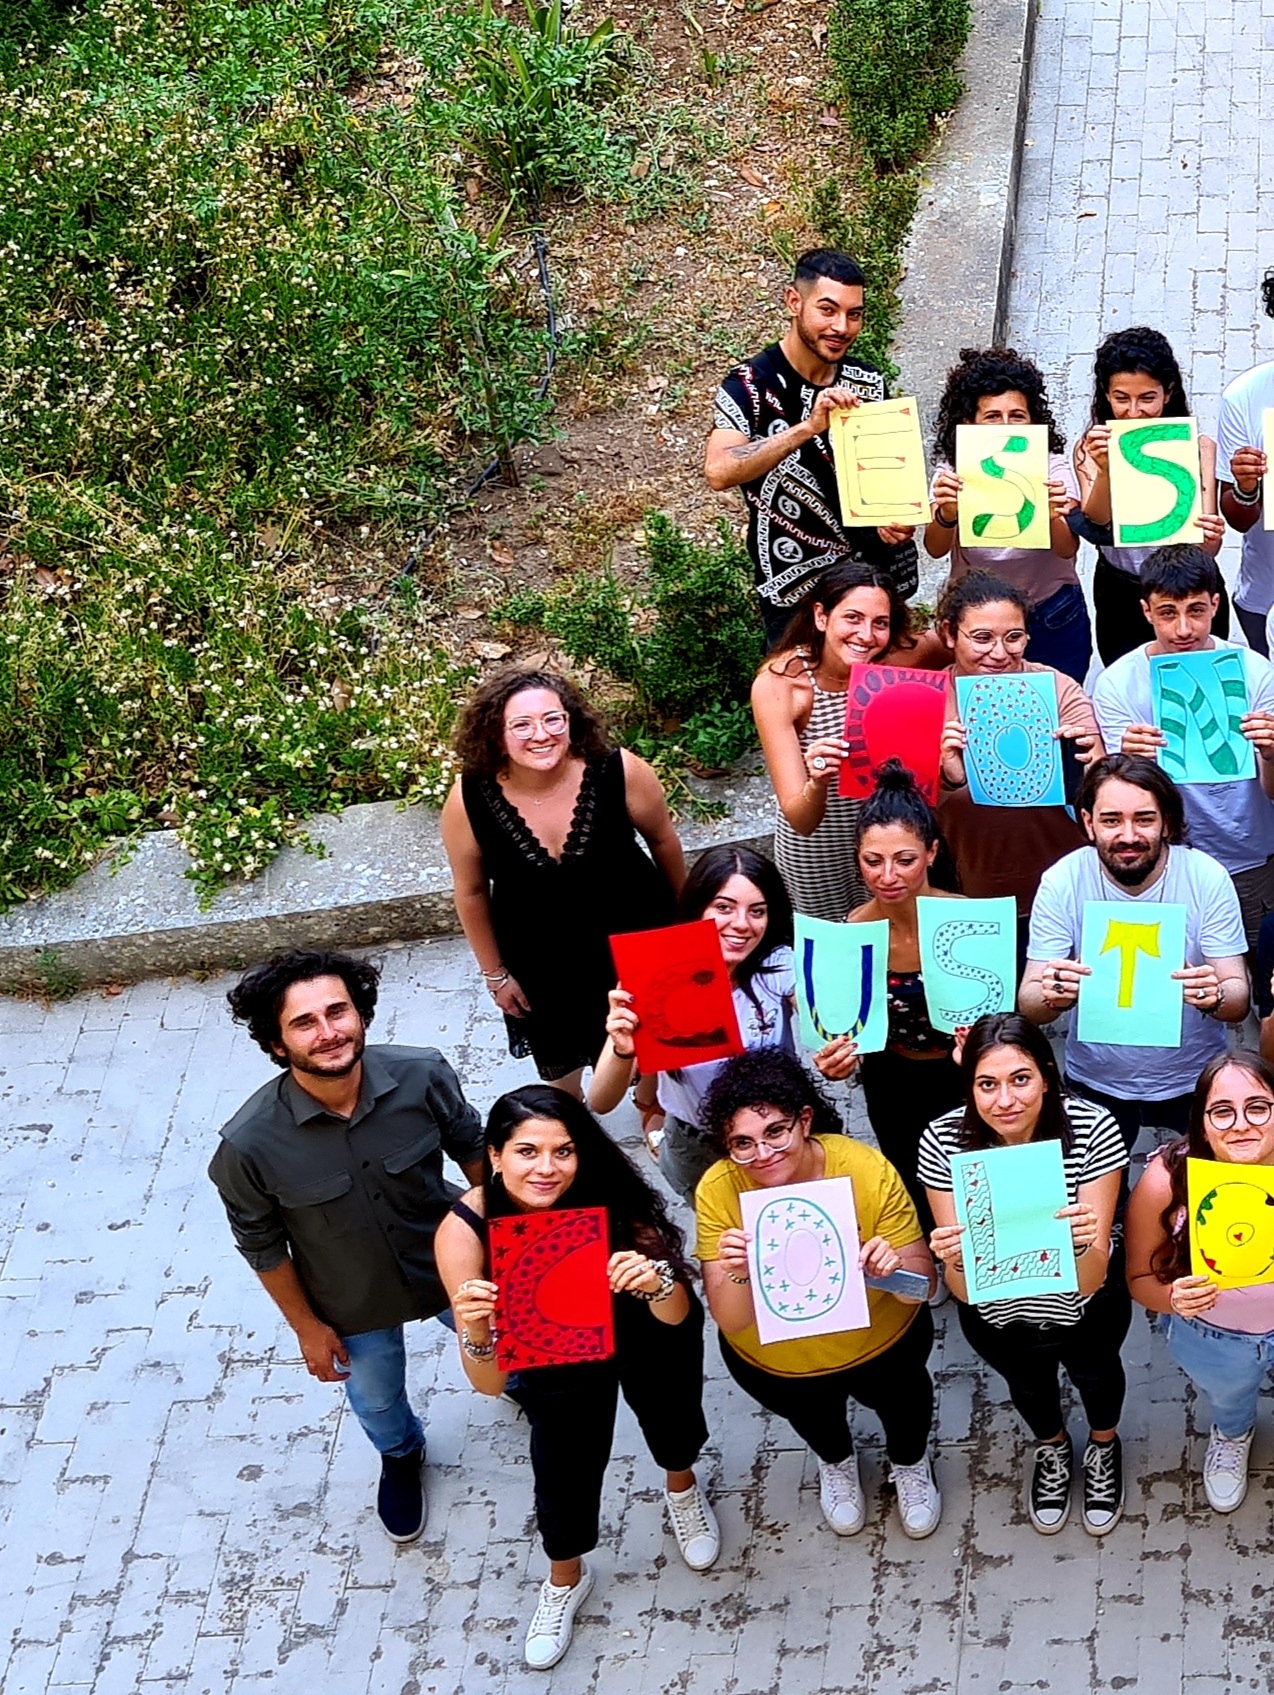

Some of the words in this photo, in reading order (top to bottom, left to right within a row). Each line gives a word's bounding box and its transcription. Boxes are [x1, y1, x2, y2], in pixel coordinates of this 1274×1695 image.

[841, 408, 922, 518] E
[971, 435, 1035, 538] S
[1118, 424, 1197, 543] S
[848, 669, 945, 797] C
[965, 676, 1050, 804] O
[1158, 652, 1246, 779] N
[644, 958, 729, 1048] C
[804, 938, 873, 1042] U
[933, 921, 1003, 1024] S
[1100, 918, 1160, 1008] T
[755, 1196, 846, 1322] O
[962, 1161, 1060, 1290] L
[507, 1214, 607, 1357] C
